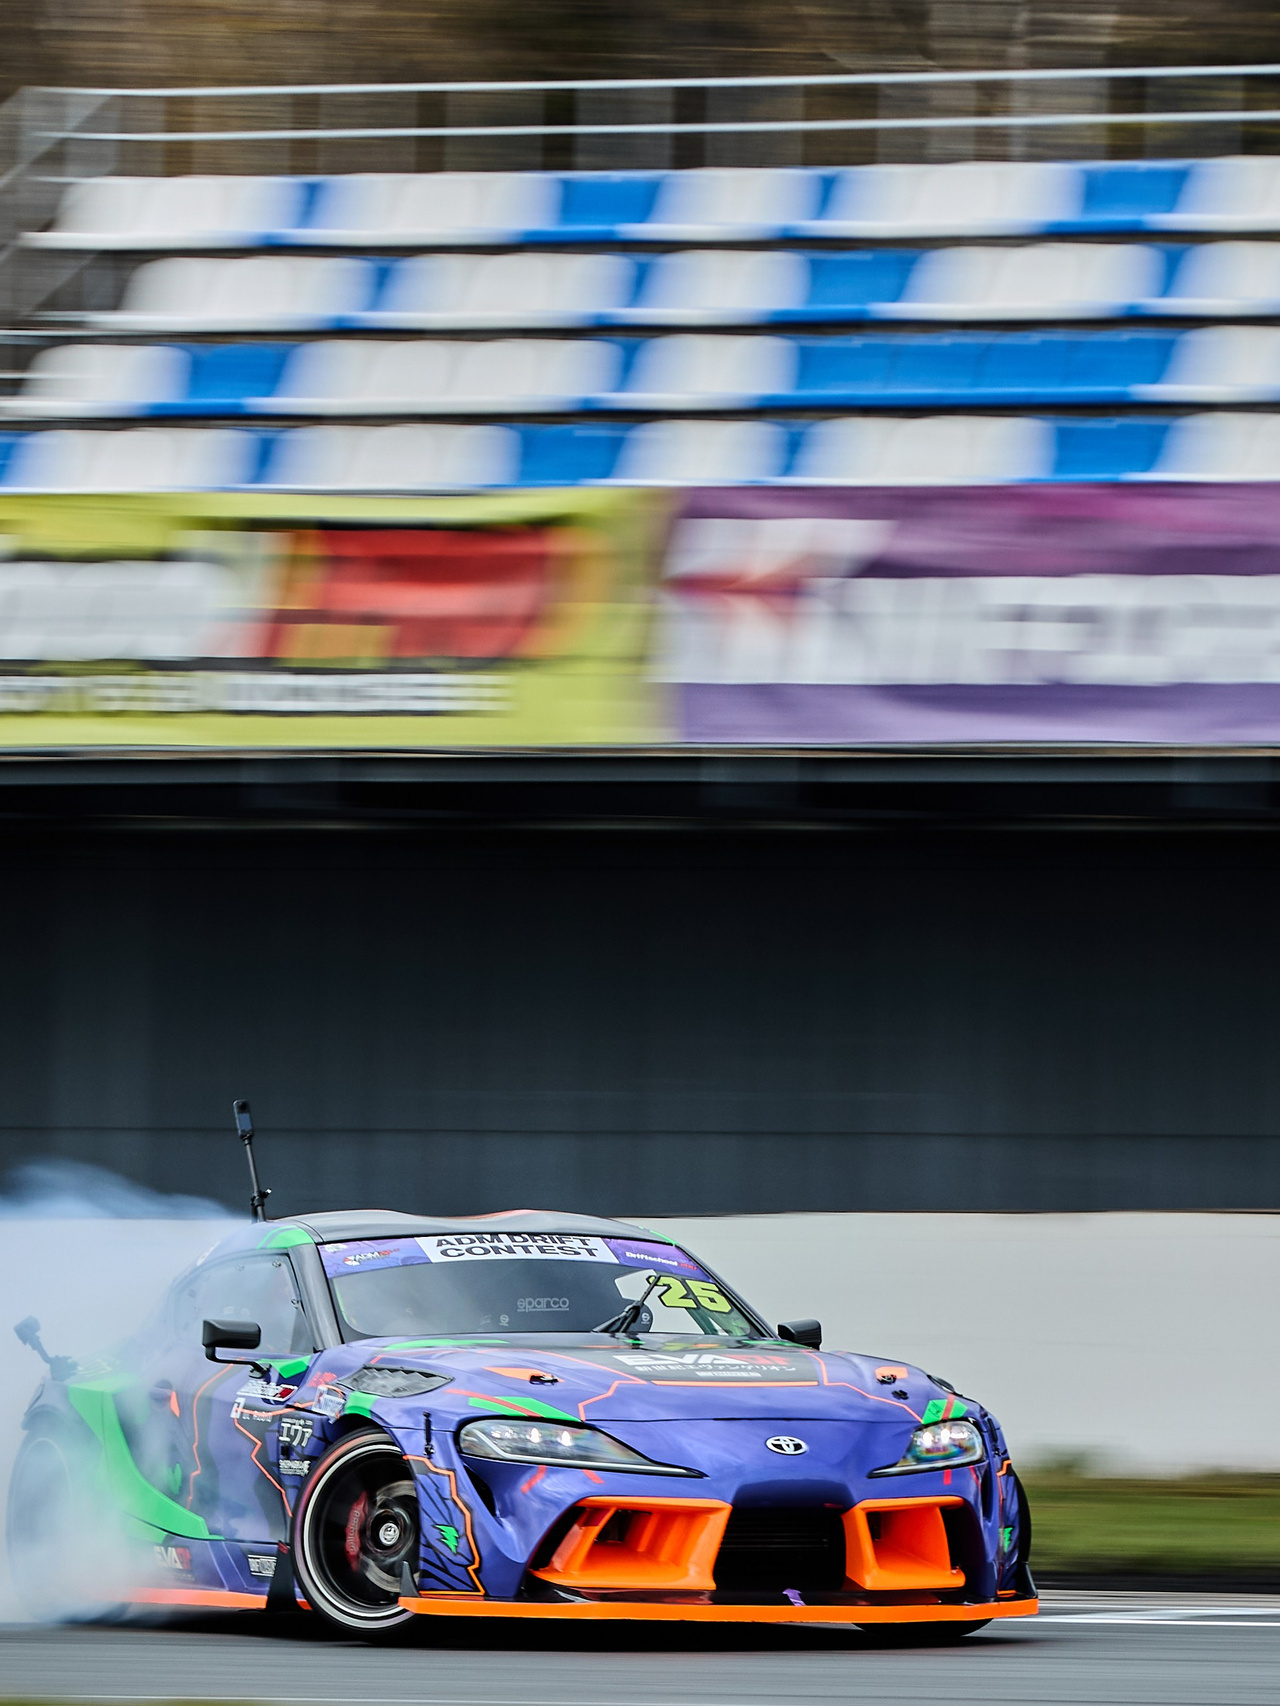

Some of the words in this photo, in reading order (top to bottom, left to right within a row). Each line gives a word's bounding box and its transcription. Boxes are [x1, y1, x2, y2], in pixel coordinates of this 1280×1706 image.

[436, 1235, 504, 1247] ADM
[506, 1234, 591, 1246] DRIFT
[440, 1244, 599, 1258] CONTEST
[646, 1274, 734, 1315] 25
[516, 1297, 570, 1312] sparco
